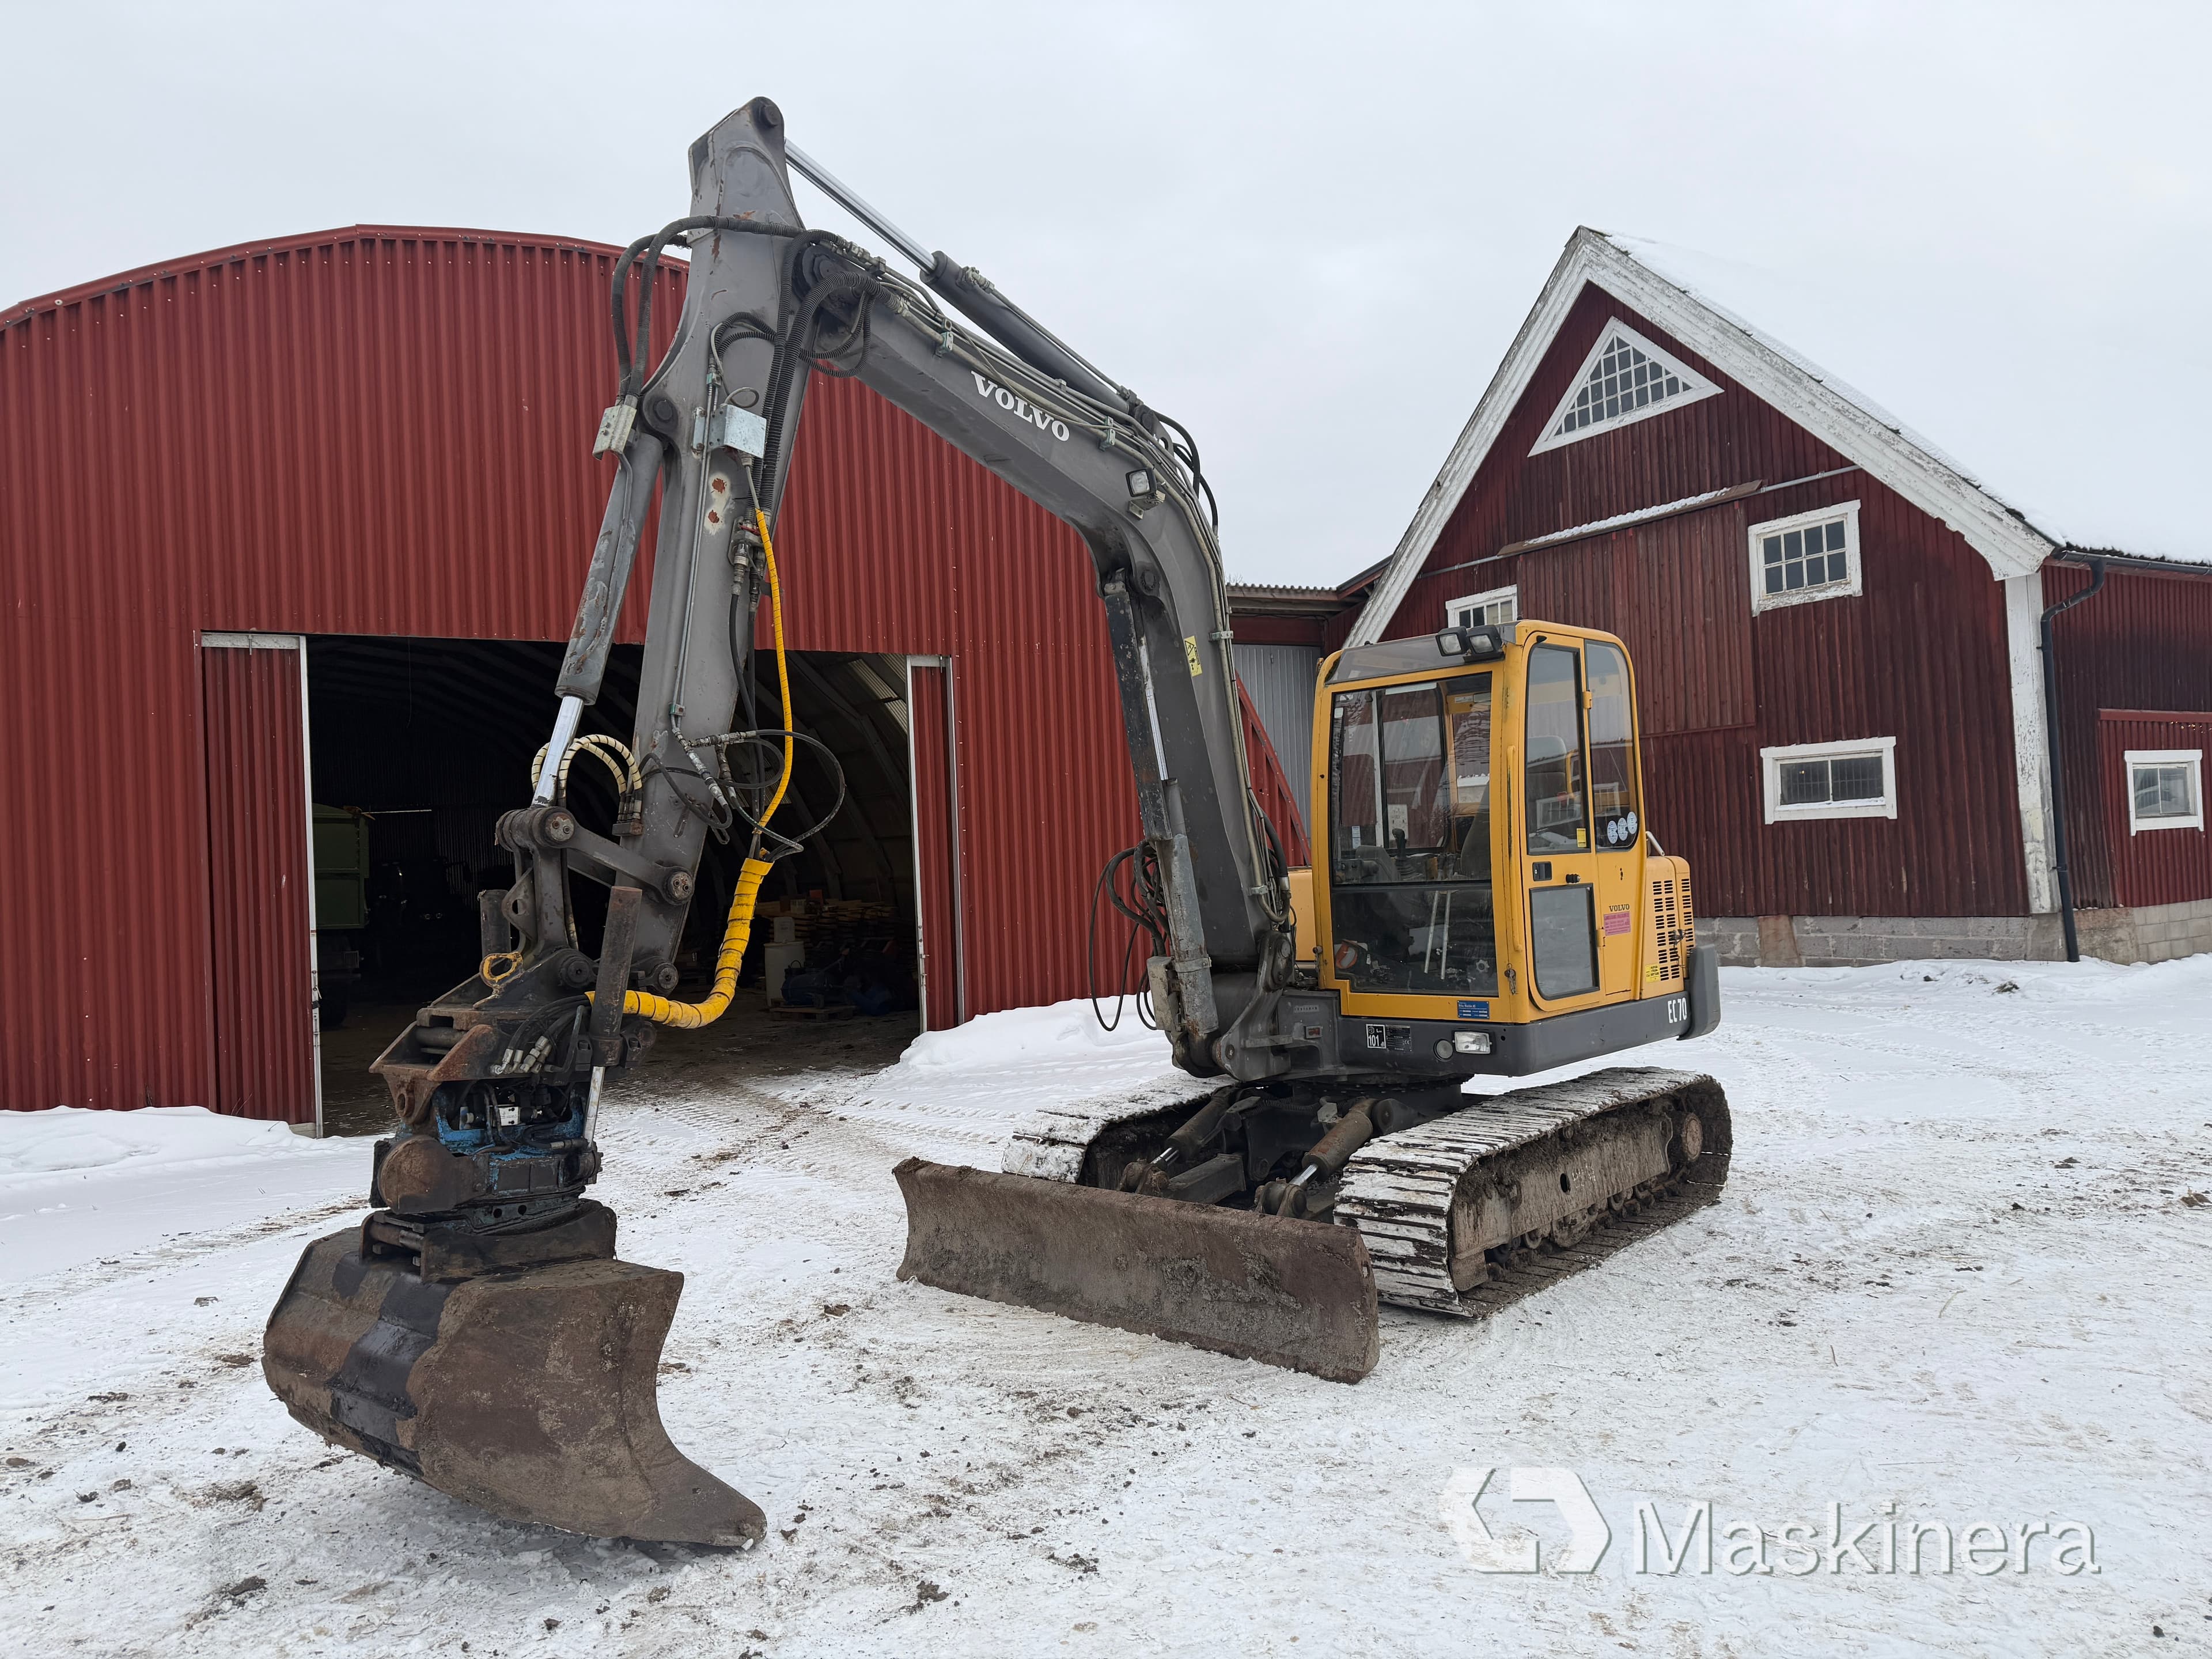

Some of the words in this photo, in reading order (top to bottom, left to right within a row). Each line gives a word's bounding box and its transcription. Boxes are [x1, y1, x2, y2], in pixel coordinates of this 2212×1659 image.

[971, 370, 1070, 441] VOLVO
[1609, 904, 1630, 912] VOLVO
[1668, 998, 1687, 1023] EC70
[1369, 1035, 1379, 1047] 101
